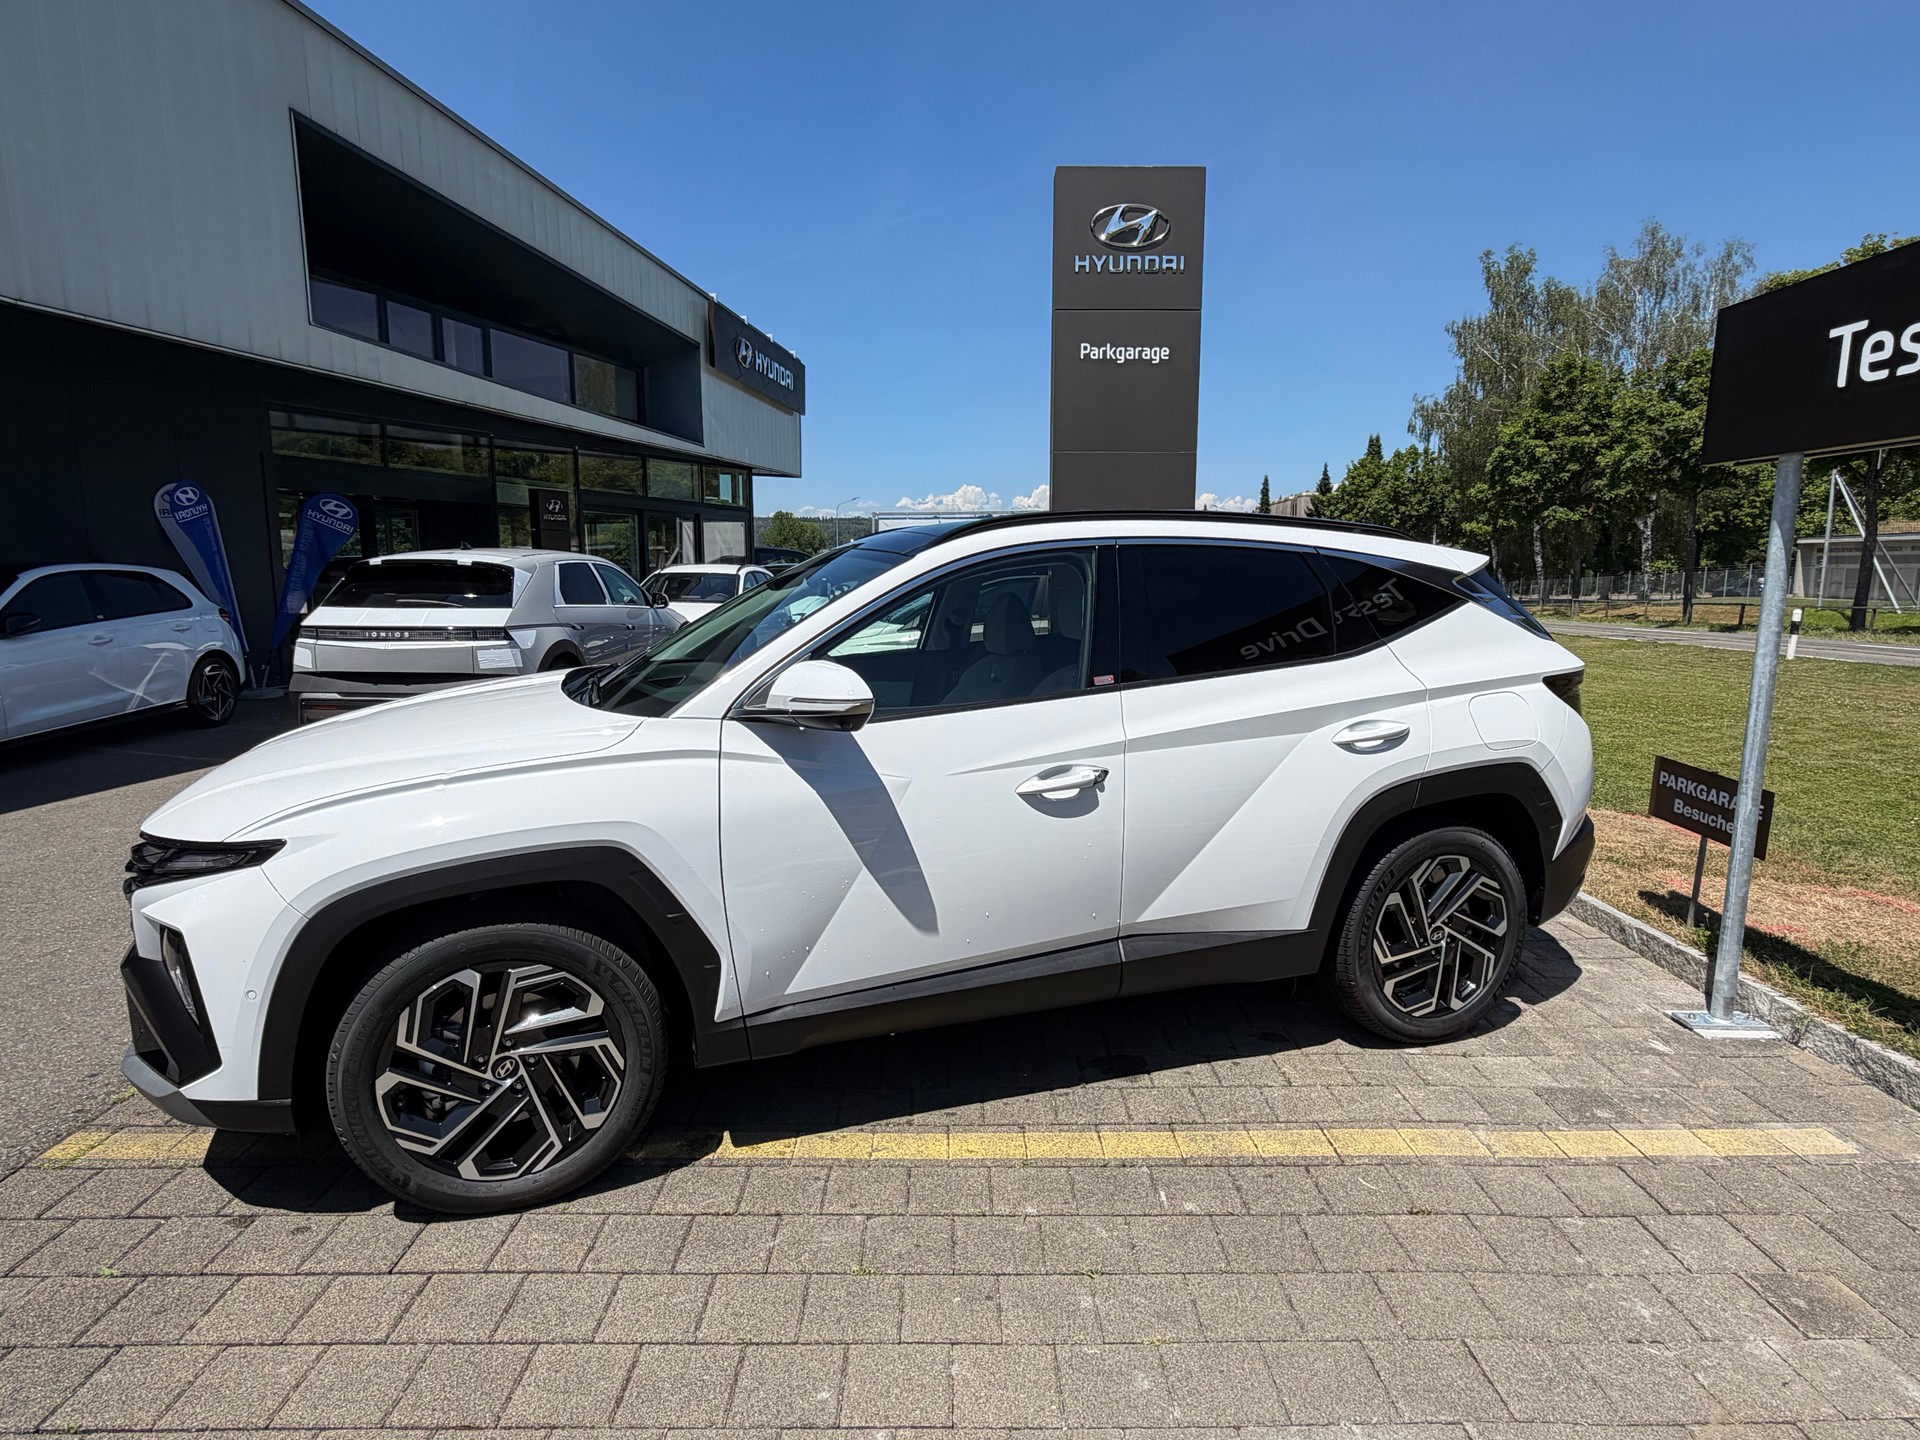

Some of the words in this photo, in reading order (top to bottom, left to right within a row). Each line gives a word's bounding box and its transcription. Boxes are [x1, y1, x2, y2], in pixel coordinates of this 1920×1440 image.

[1074, 254, 1185, 274] HYUNDAI
[1080, 343, 1170, 364] Parkgarage
[755, 350, 794, 391] HYUNDAI
[307, 509, 354, 533] HYUNDAI
[1659, 771, 1764, 820] PARKGARAE
[612, 979, 651, 1070] MICHELIN
